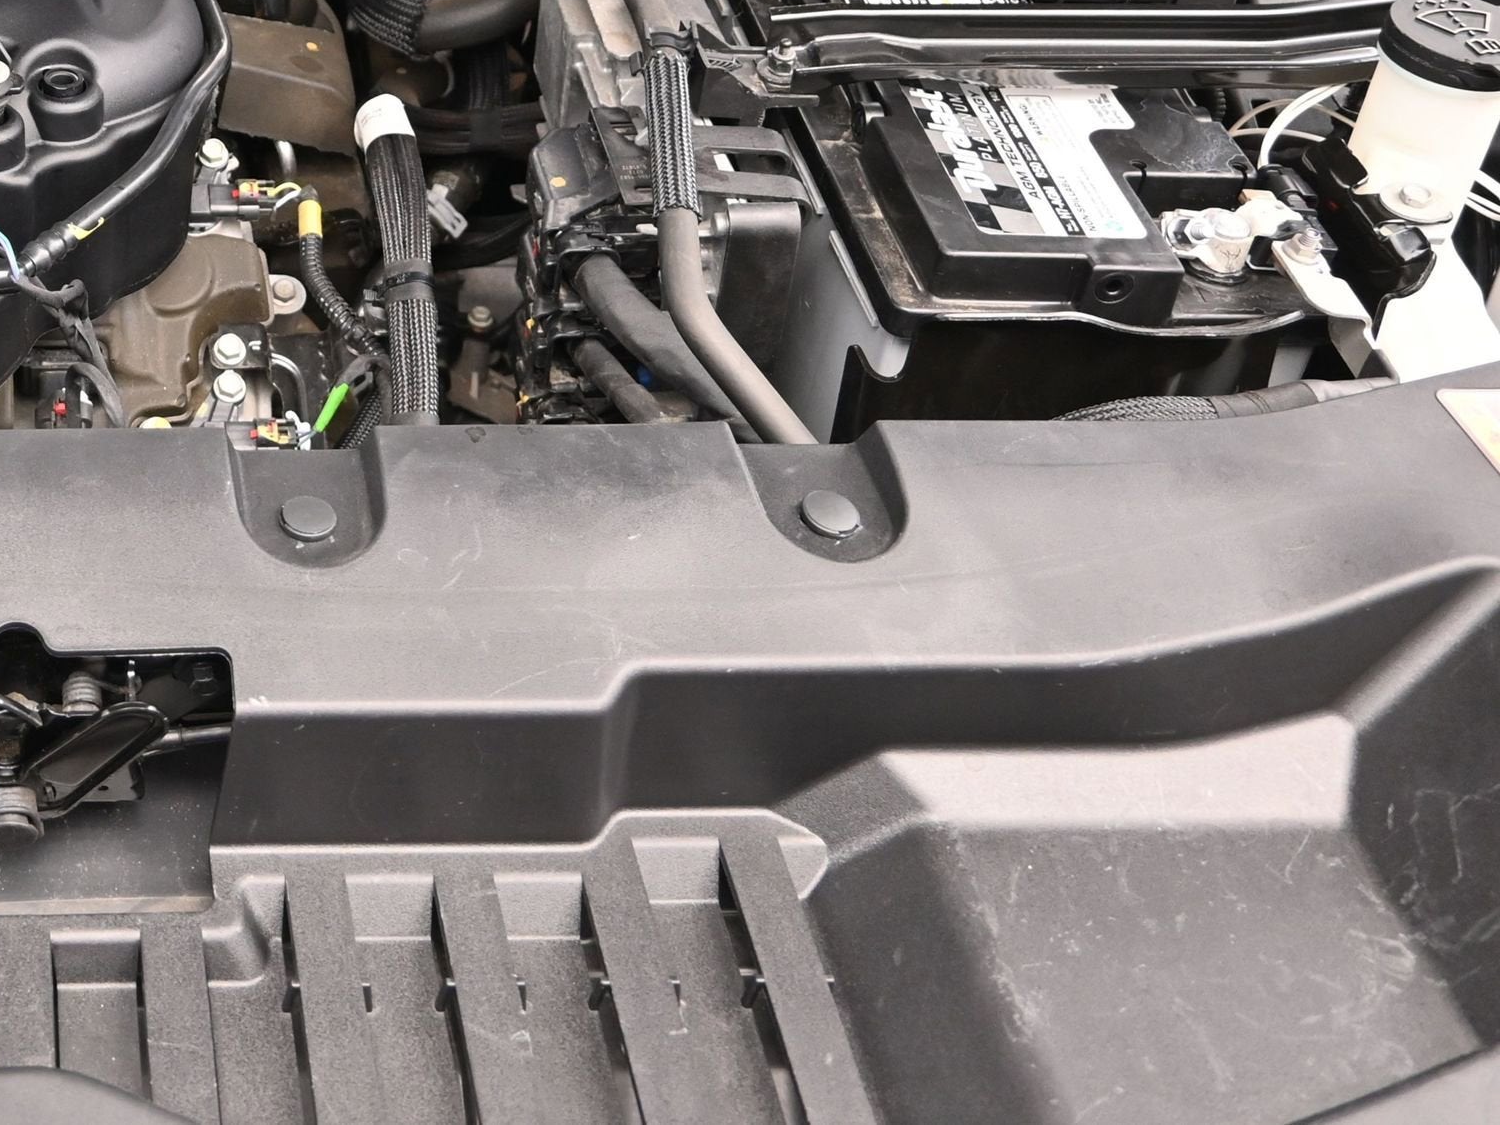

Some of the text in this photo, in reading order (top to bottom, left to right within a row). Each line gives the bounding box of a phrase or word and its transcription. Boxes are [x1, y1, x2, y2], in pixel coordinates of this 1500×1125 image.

[909, 87, 998, 193] Duralast
[946, 91, 1001, 163] PLATINUM
[968, 89, 1022, 167] TECHNOLOGY
[1017, 170, 1042, 199] AGM
